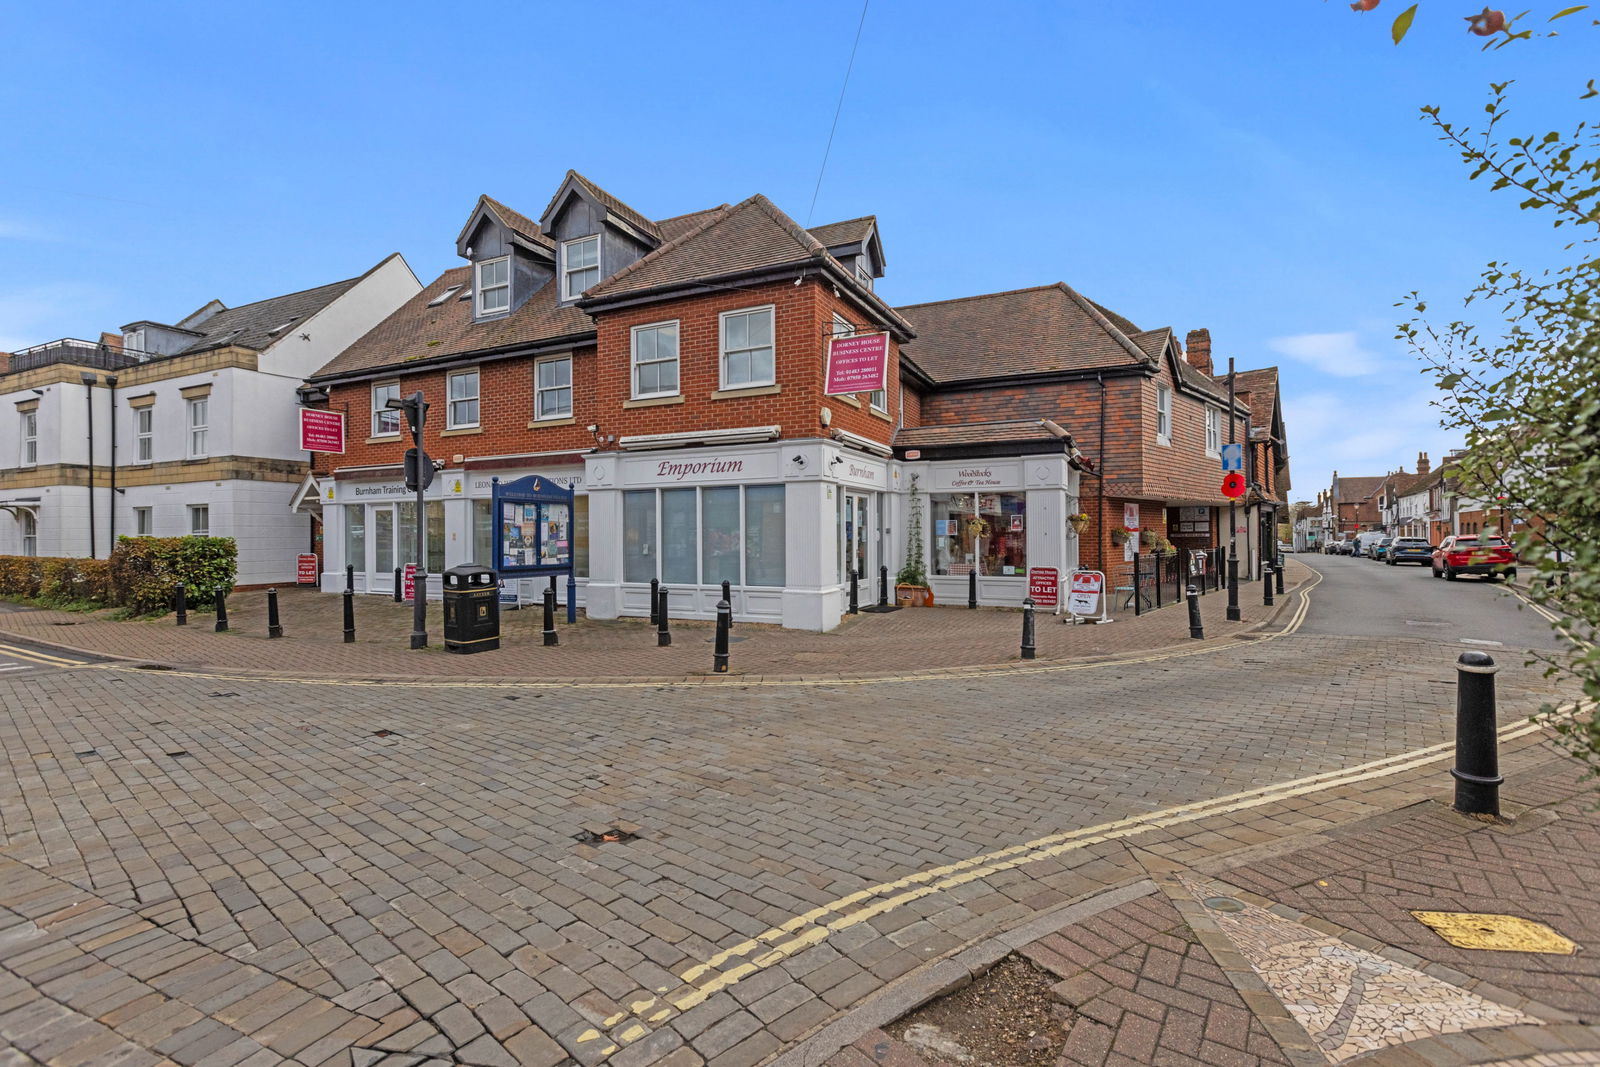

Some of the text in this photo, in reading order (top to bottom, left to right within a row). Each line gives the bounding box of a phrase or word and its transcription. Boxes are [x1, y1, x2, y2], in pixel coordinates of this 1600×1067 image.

[657, 458, 743, 480] Emporium
[849, 464, 874, 480] Burnham
[958, 468, 992, 478] Woodstocks
[356, 486, 382, 496] Burnham
[382, 484, 406, 494] Training
